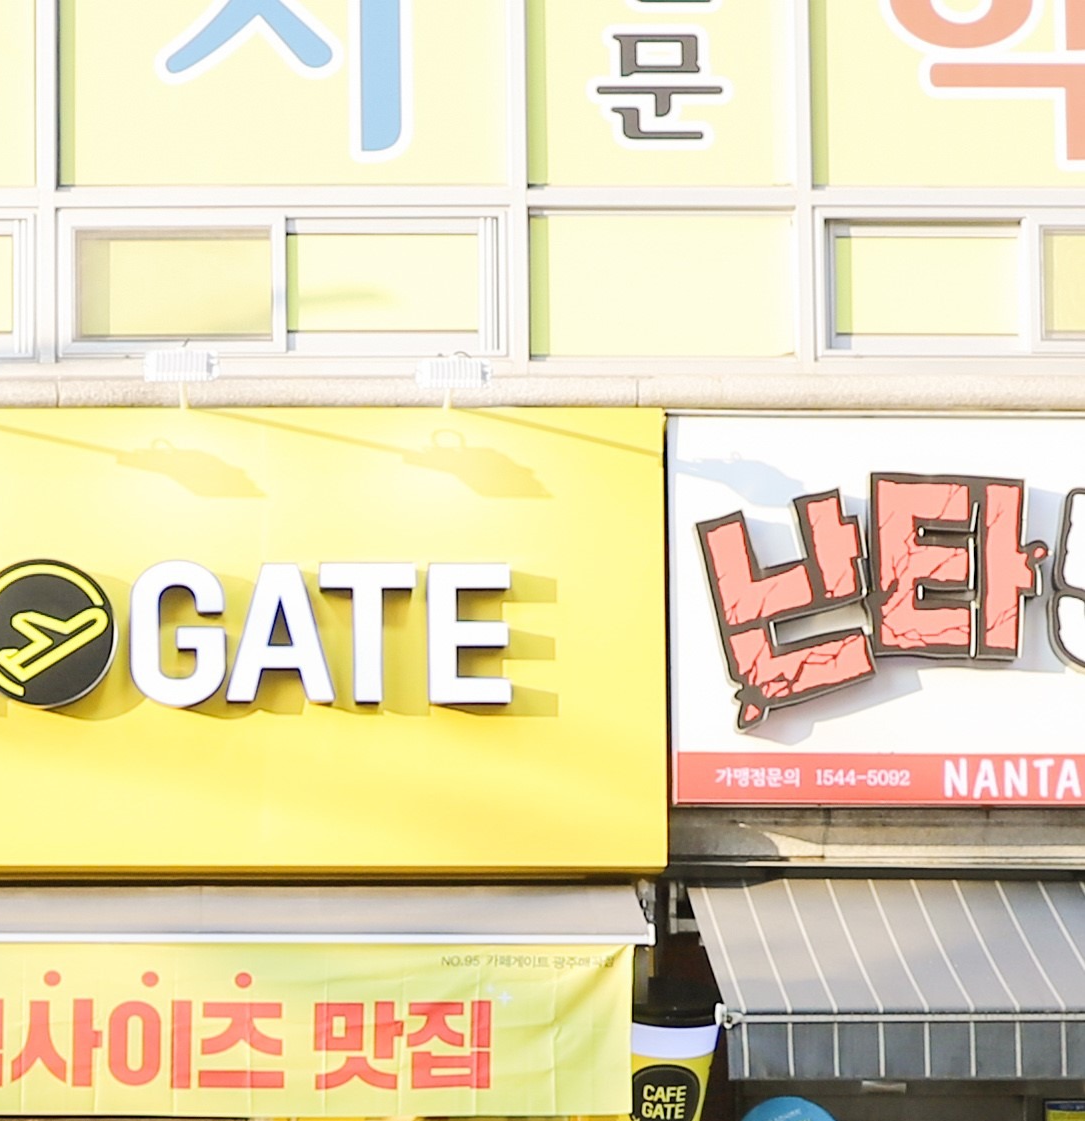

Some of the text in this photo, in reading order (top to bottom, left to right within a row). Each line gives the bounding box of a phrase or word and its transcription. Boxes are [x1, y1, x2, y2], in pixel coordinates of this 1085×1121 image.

[128, 559, 512, 709] GATE
[715, 766, 911, 788] 가맹점문의 1544-5092
[943, 757, 1082, 799] NANTA
[440, 954, 481, 968] NO.95
[313, 999, 492, 1090] 맛집
[643, 1084, 687, 1103] CAFE
[641, 1102, 685, 1120] GATE
